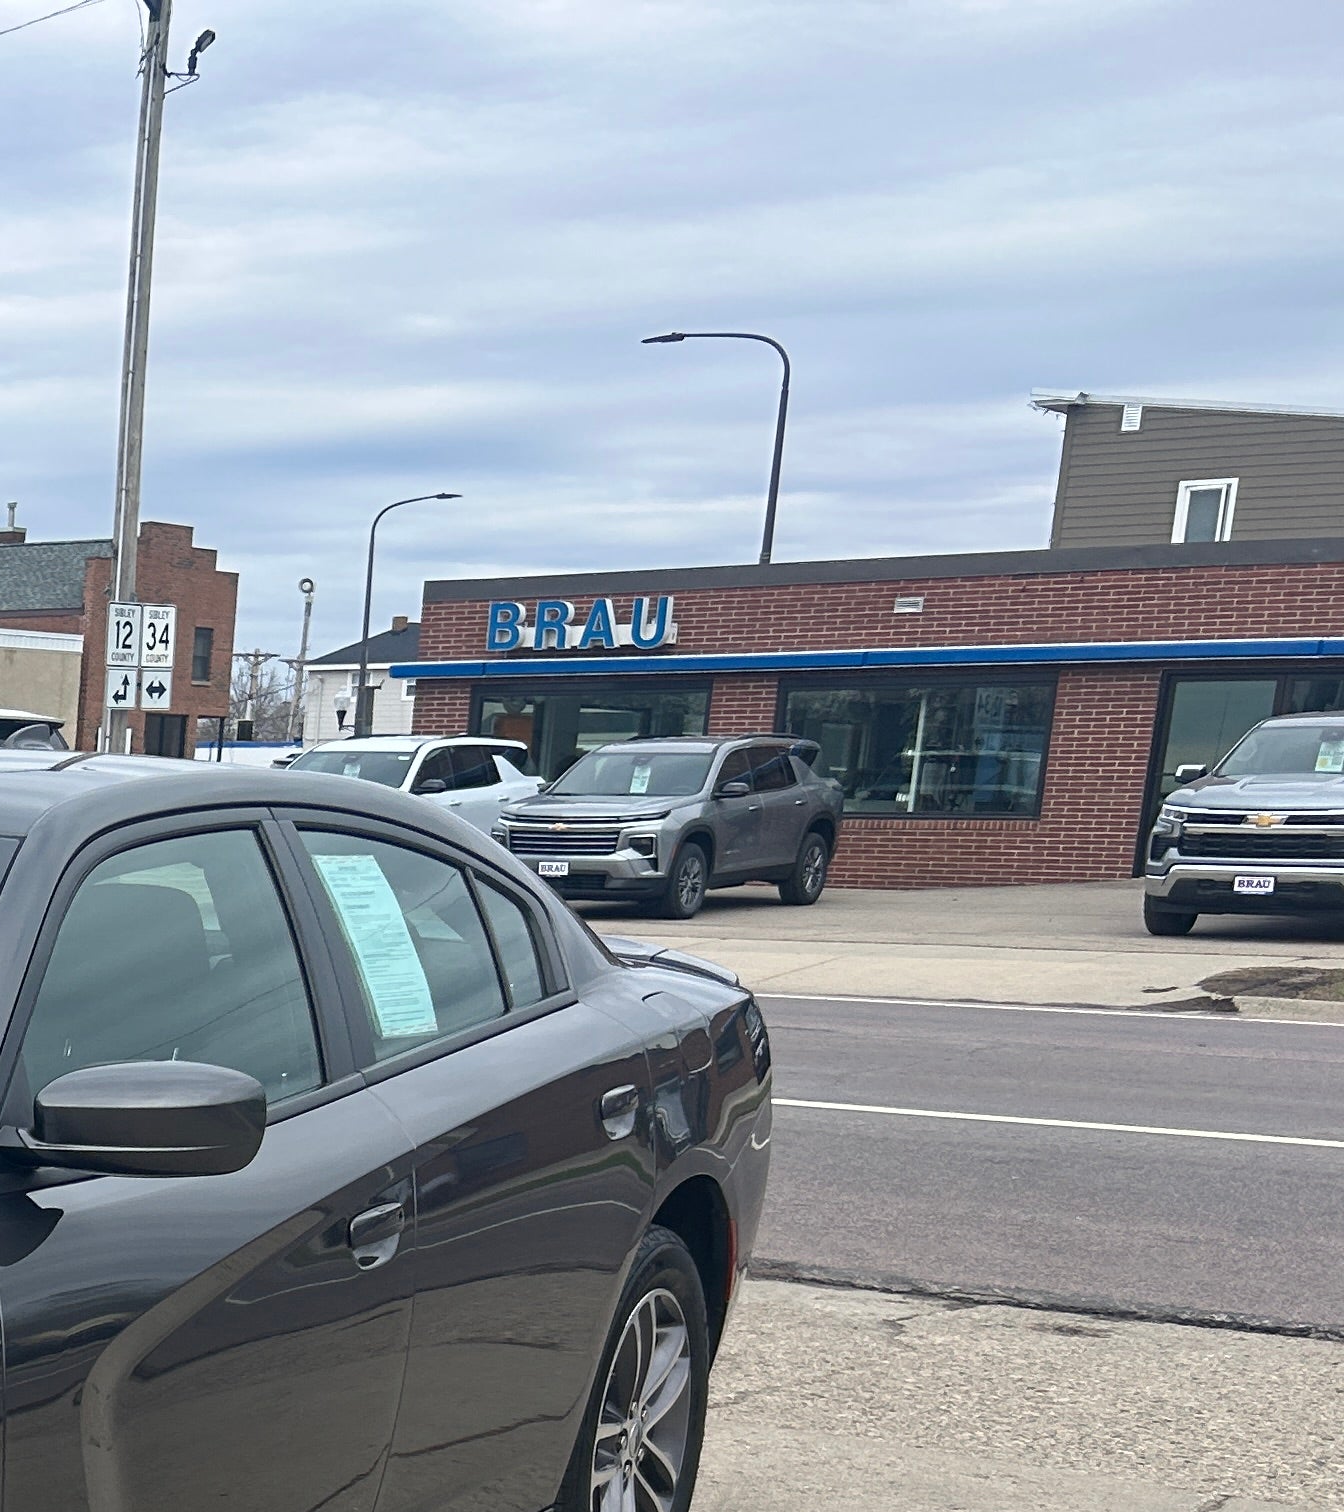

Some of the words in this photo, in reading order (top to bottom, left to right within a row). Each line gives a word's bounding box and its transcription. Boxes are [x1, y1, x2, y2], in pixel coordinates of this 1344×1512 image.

[114, 608, 136, 618] SIBLEY
[149, 610, 171, 620] SIBLEY
[486, 596, 672, 651] BRAU
[115, 620, 133, 649] 12
[146, 622, 170, 651] 34
[111, 652, 135, 662] COUNTY
[146, 654, 169, 663] COUNTY
[540, 864, 566, 873] BRAU
[1237, 879, 1272, 888] BRAU
